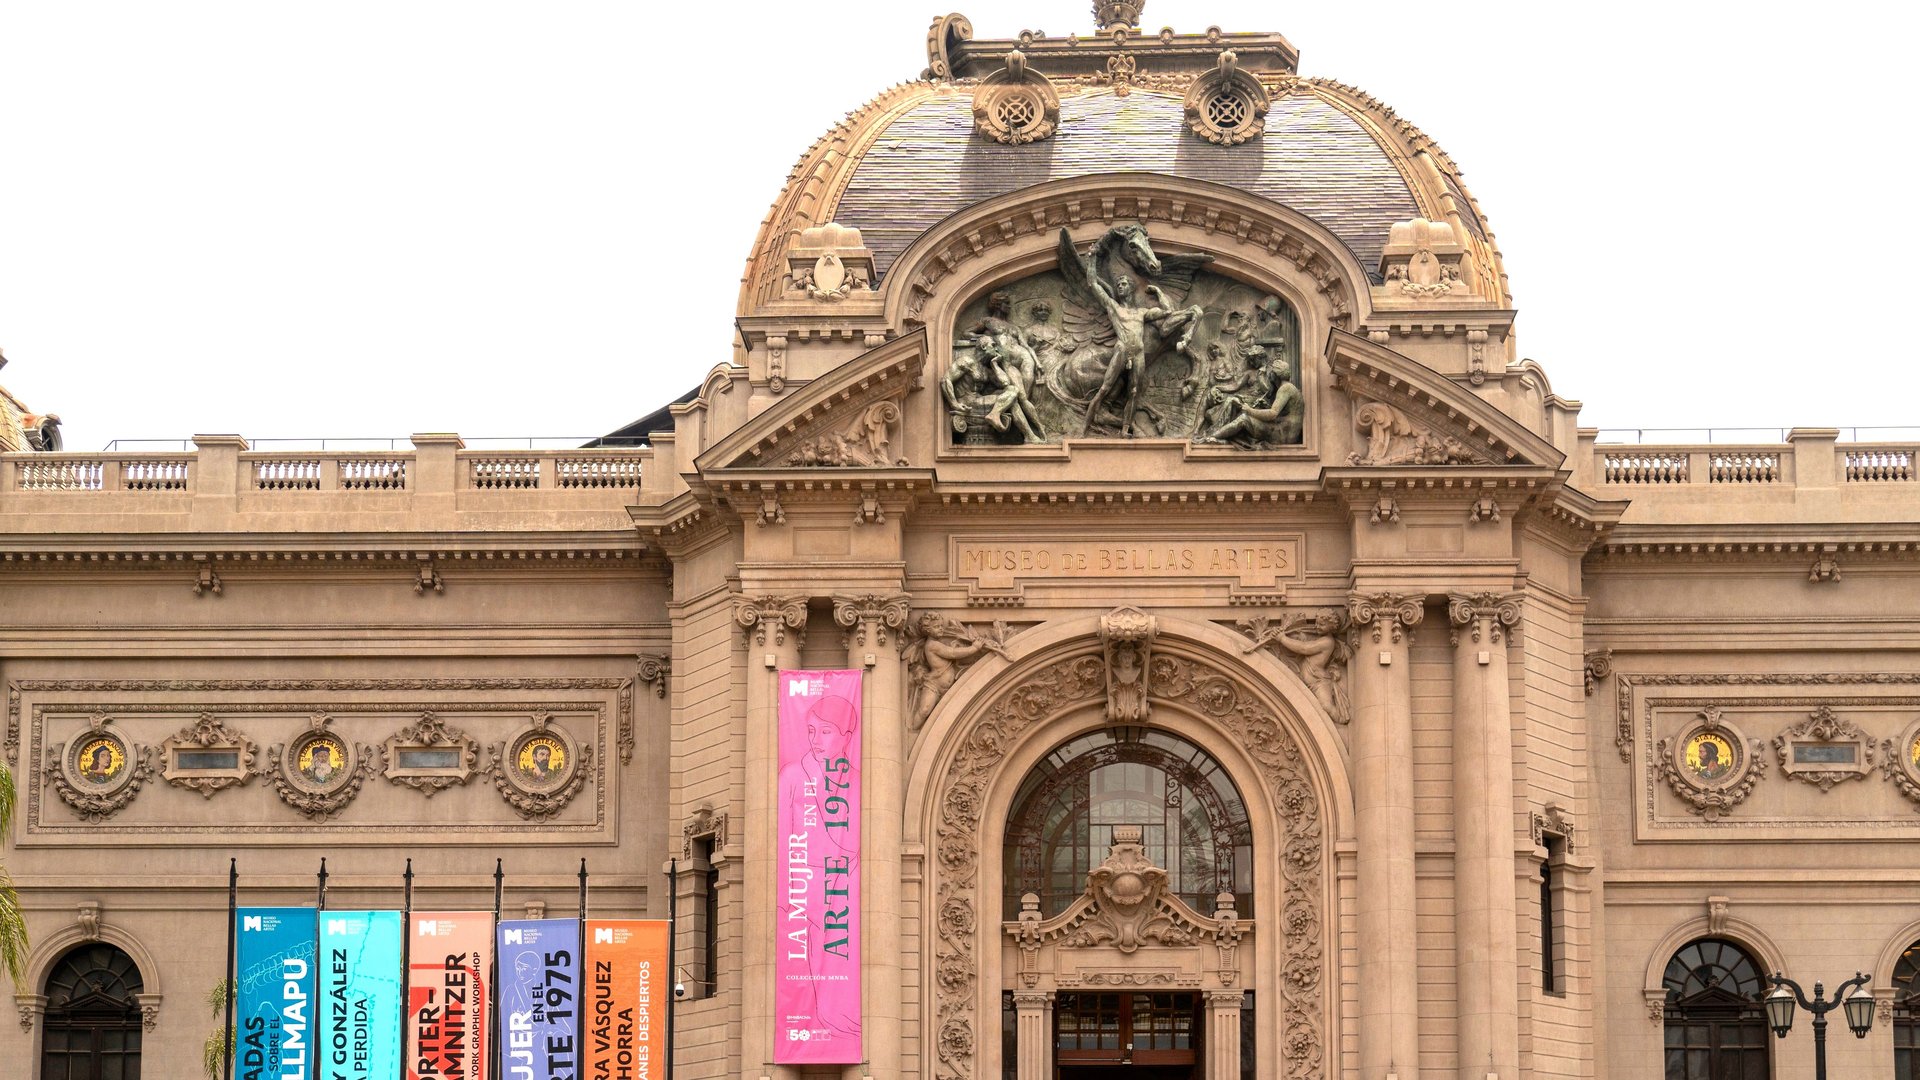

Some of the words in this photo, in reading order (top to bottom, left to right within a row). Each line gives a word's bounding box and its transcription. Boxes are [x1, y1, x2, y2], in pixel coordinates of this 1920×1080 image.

[966, 550, 1050, 571] MUSEO
[1062, 553, 1087, 571] DE
[1099, 549, 1195, 570] BELLAS
[1210, 548, 1289, 570] ARTES
[789, 680, 808, 697] M
[804, 777, 817, 797] EL
[824, 757, 850, 832] 1975
[804, 804, 817, 827] EN
[788, 831, 813, 921] MUJER
[244, 916, 261, 931] M
[824, 855, 849, 961] ARTE
[419, 920, 436, 936] M
[505, 929, 522, 945] M
[595, 928, 612, 944] M
[788, 928, 808, 961] LA
[532, 983, 543, 998] EL
[545, 950, 572, 1024] 1975
[639, 961, 650, 1041] DESPIERTOS
[270, 1016, 280, 1029] EL
[282, 958, 307, 1080] LLMAPU
[330, 949, 347, 1065] GONZÁLEZ
[444, 952, 466, 1080] MNITZER
[533, 1003, 544, 1022] EN
[592, 961, 614, 1053] VÁSQUEZ
[244, 1016, 265, 1080] ADAS
[354, 998, 367, 1071] PERDIDA
[472, 1008, 480, 1049] GRAPHIC
[616, 1007, 633, 1080] HORRA
[269, 1033, 279, 1071] SOBRE
